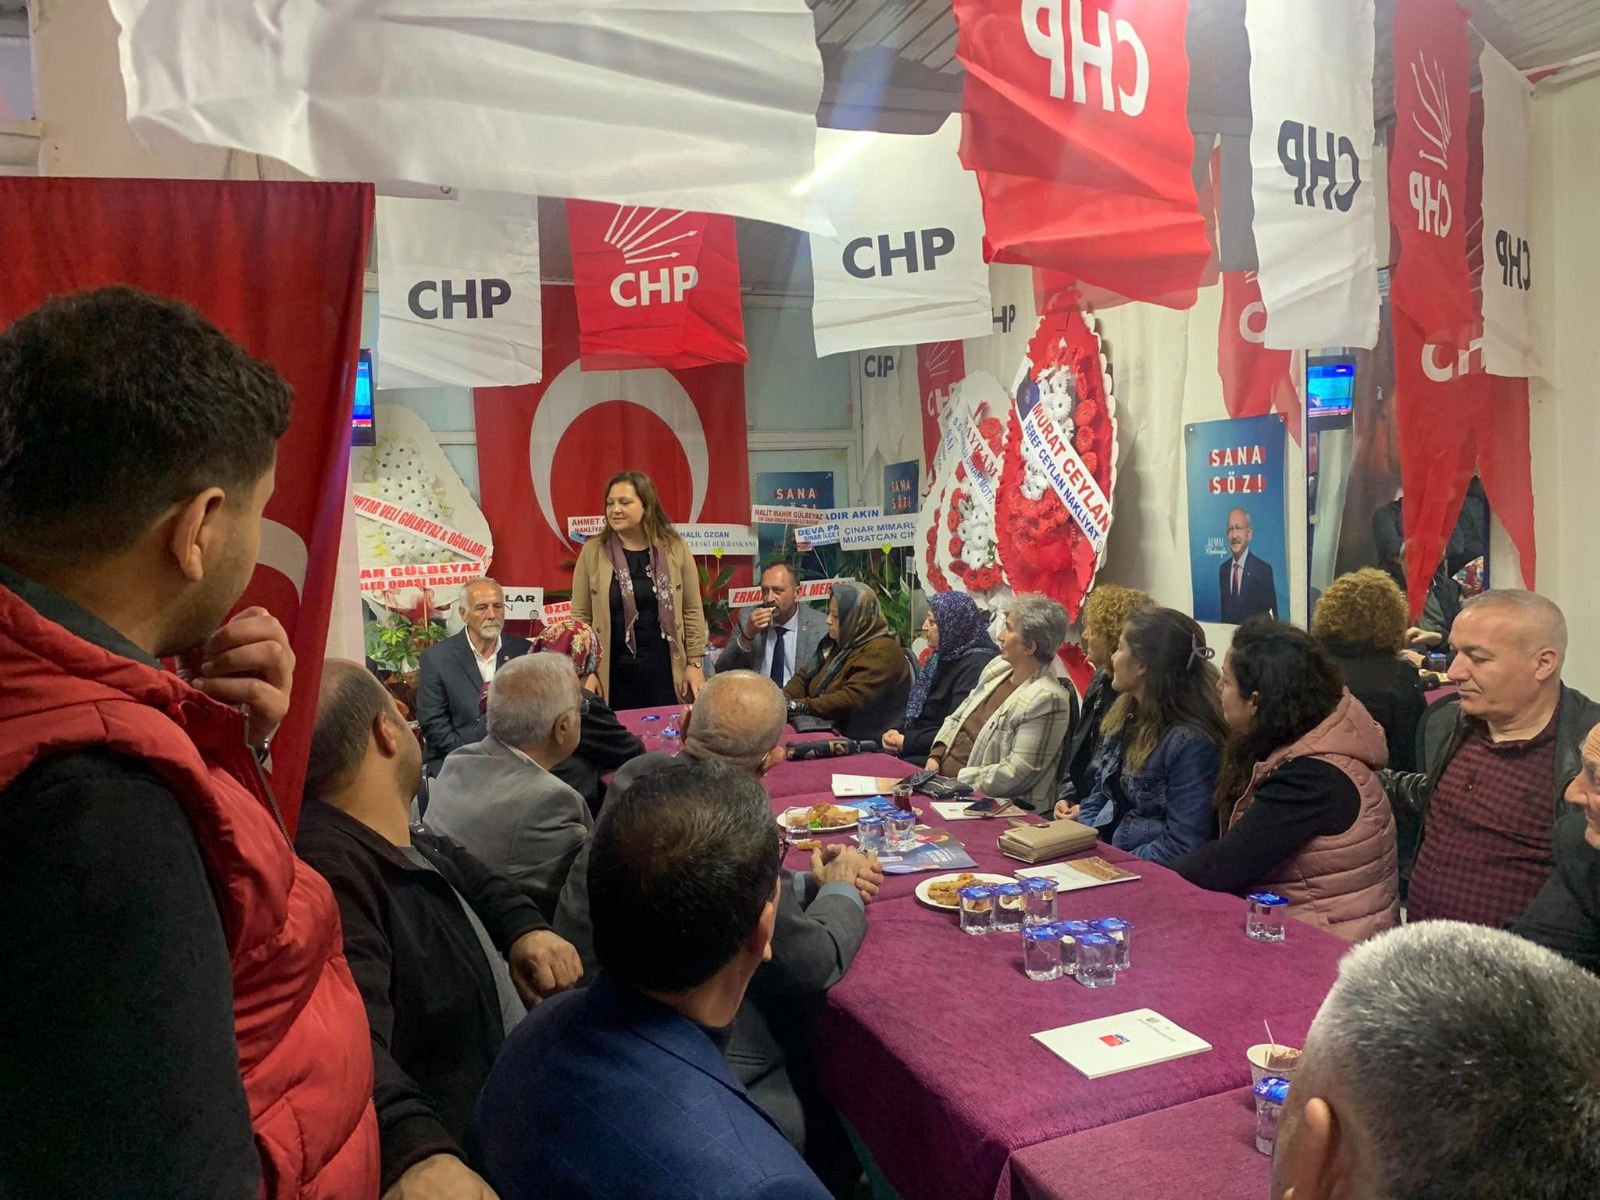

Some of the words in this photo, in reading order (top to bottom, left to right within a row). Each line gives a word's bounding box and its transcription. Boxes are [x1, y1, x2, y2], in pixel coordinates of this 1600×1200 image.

[842, 227, 956, 279] CHP
[610, 265, 699, 307] CHP
[407, 278, 512, 320] CHP
[991, 303, 1016, 332] HP
[1211, 445, 1263, 468] SANA
[1032, 402, 1067, 457] MURAT
[1062, 457, 1111, 533] CEYLAN
[891, 480, 911, 492] SANA
[1024, 420, 1043, 450] ŞEREF
[1038, 448, 1066, 491] CEYLAN
[1063, 487, 1100, 541] NAKLİYAT
[1212, 471, 1263, 495] SÖZ!
[776, 488, 816, 500] SANA
[754, 508, 773, 516] HALİT
[773, 509, 793, 518] MAHİR
[793, 511, 824, 520] GÜLBEYAZ
[825, 511, 849, 520] ADIR
[852, 510, 879, 519] AKIN
[353, 494, 380, 515] UHTAR
[379, 503, 403, 523] VELİ
[398, 511, 444, 539] GÜLBEYAZ
[439, 531, 448, 542] &
[447, 532, 487, 558] OĞULLARI
[572, 518, 600, 526] AHMET
[844, 525, 874, 535] ÇINAR
[877, 521, 916, 531] MİMARL
[797, 527, 825, 536] DEVA
[842, 533, 898, 544] MURATCAN
[360, 568, 386, 579] AR
[390, 562, 482, 577] GÜLBEYAZ
[505, 594, 536, 603] LAR
[732, 589, 764, 604] ERKA
[544, 602, 571, 615] ÖZD
